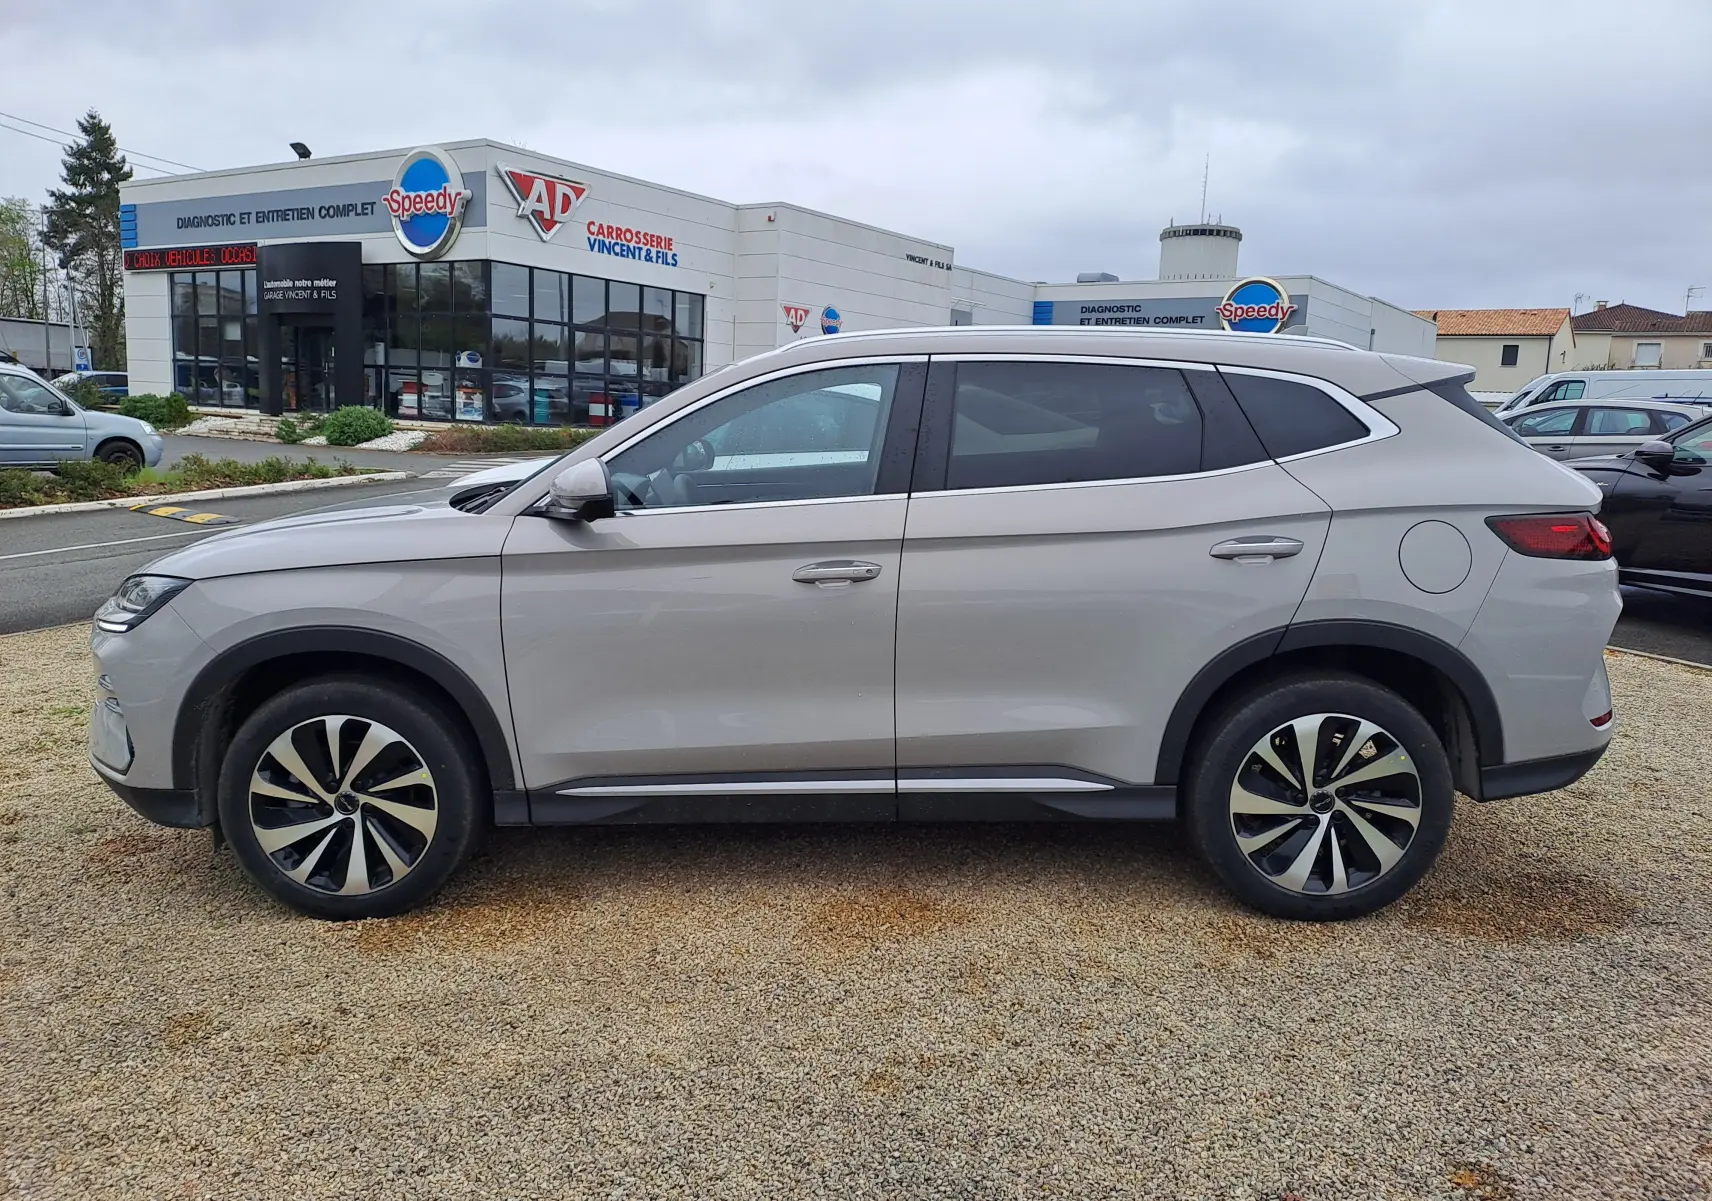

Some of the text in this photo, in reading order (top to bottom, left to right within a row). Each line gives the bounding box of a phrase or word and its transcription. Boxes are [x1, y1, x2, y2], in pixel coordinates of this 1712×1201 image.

[383, 186, 462, 218] Speedy
[520, 178, 578, 222] AD
[176, 202, 376, 229] DIAGNOSTIC ET ENTRETIEN COMPLET
[586, 221, 673, 251] CARROSSERIE
[133, 251, 160, 268] CHOIX
[587, 237, 678, 267] VINCENT & FILS
[906, 253, 928, 265] VINCENT
[935, 260, 944, 269] FILS
[263, 278, 337, 289] L'automobile notre métier
[263, 290, 337, 300] GARAGE VINCENT & FILS
[786, 308, 806, 326] AD
[1080, 304, 1142, 314] DIAGNOSTIC
[1216, 301, 1294, 321] Speedy
[1079, 315, 1205, 326] ET ENTRETIEN COMPLET
